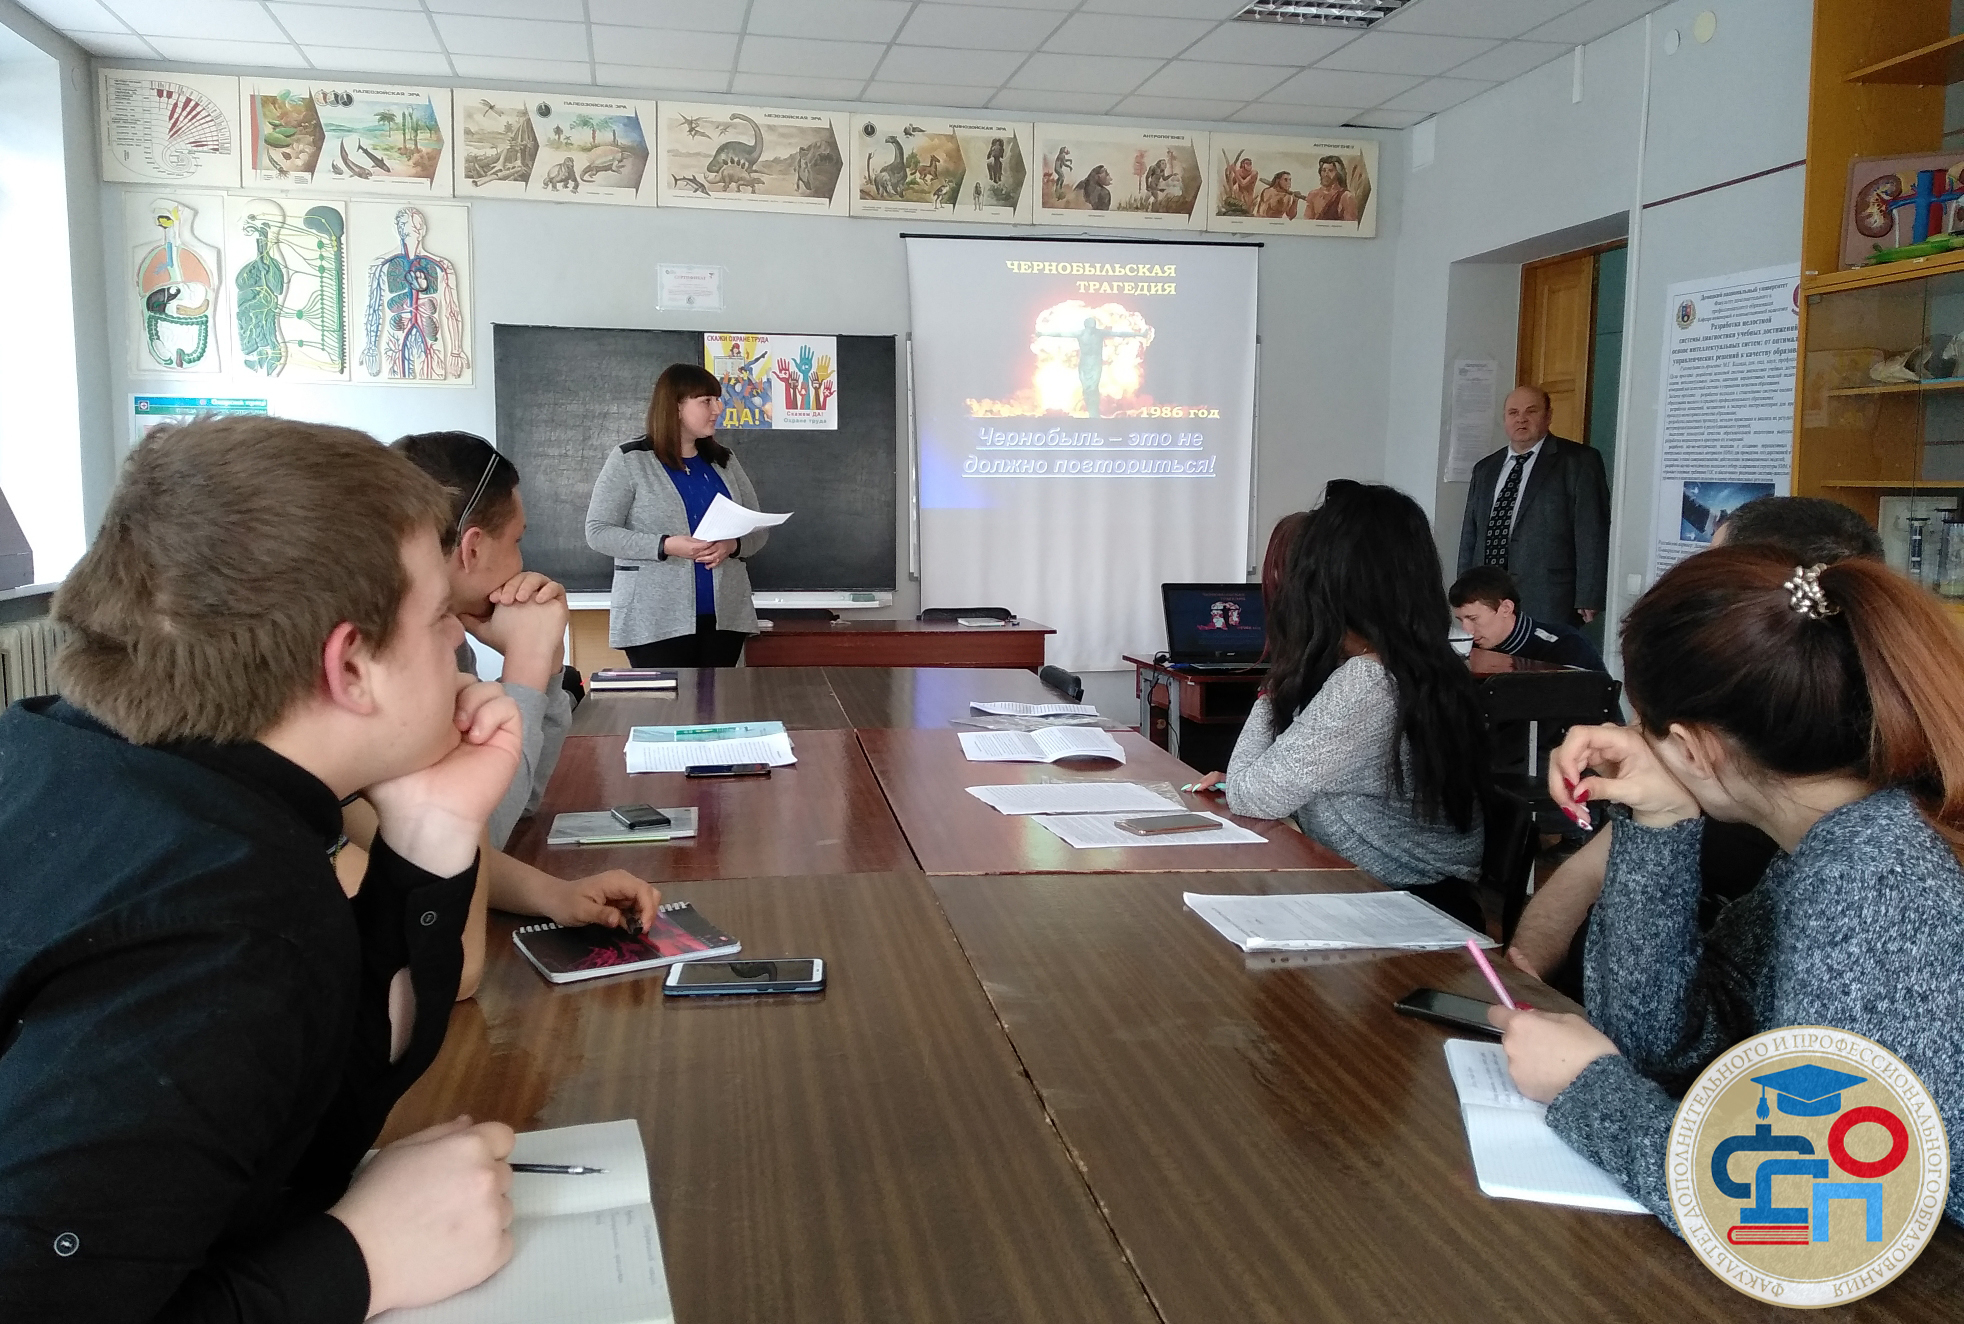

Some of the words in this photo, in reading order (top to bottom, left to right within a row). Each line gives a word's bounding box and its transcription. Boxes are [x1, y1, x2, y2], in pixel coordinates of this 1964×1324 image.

[1006, 260, 1177, 277] ЧЕРНОБЫЛЬСКАЯ
[1077, 281, 1177, 296] ТРАГЕДИЯ
[723, 408, 760, 429] ДА!
[1140, 407, 1183, 418] 1986
[1189, 408, 1220, 419] год
[979, 427, 1104, 447] Чернобыль
[1128, 432, 1172, 446] это
[1177, 432, 1203, 446] не
[963, 455, 1048, 474] должно
[1054, 455, 1216, 475] повториться!
